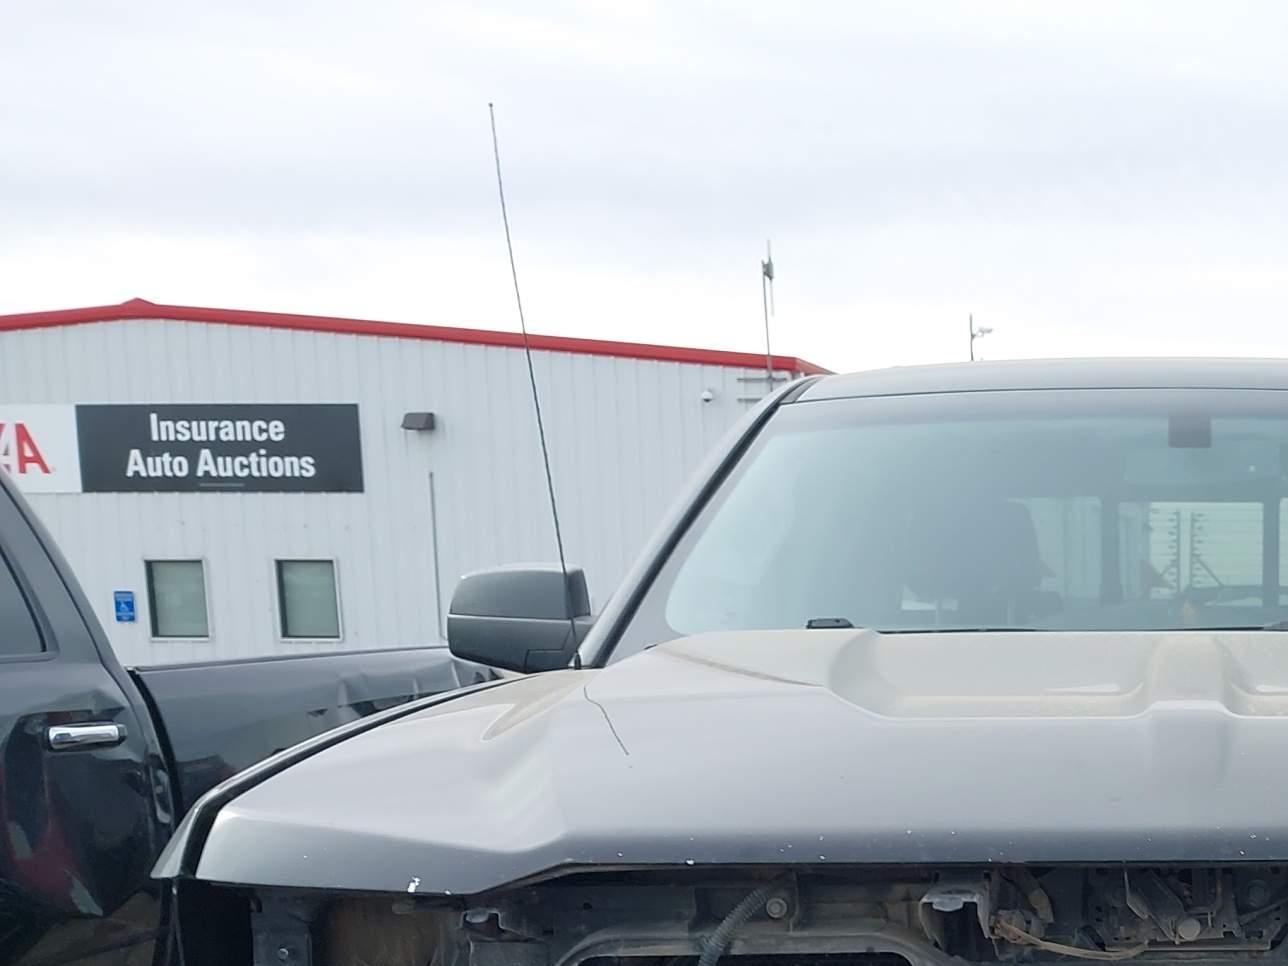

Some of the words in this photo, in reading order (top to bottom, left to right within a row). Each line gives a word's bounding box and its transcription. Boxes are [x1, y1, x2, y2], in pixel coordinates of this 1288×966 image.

[150, 413, 285, 441] Insurance
[126, 449, 189, 477] Auto
[196, 448, 316, 477] Auctions
